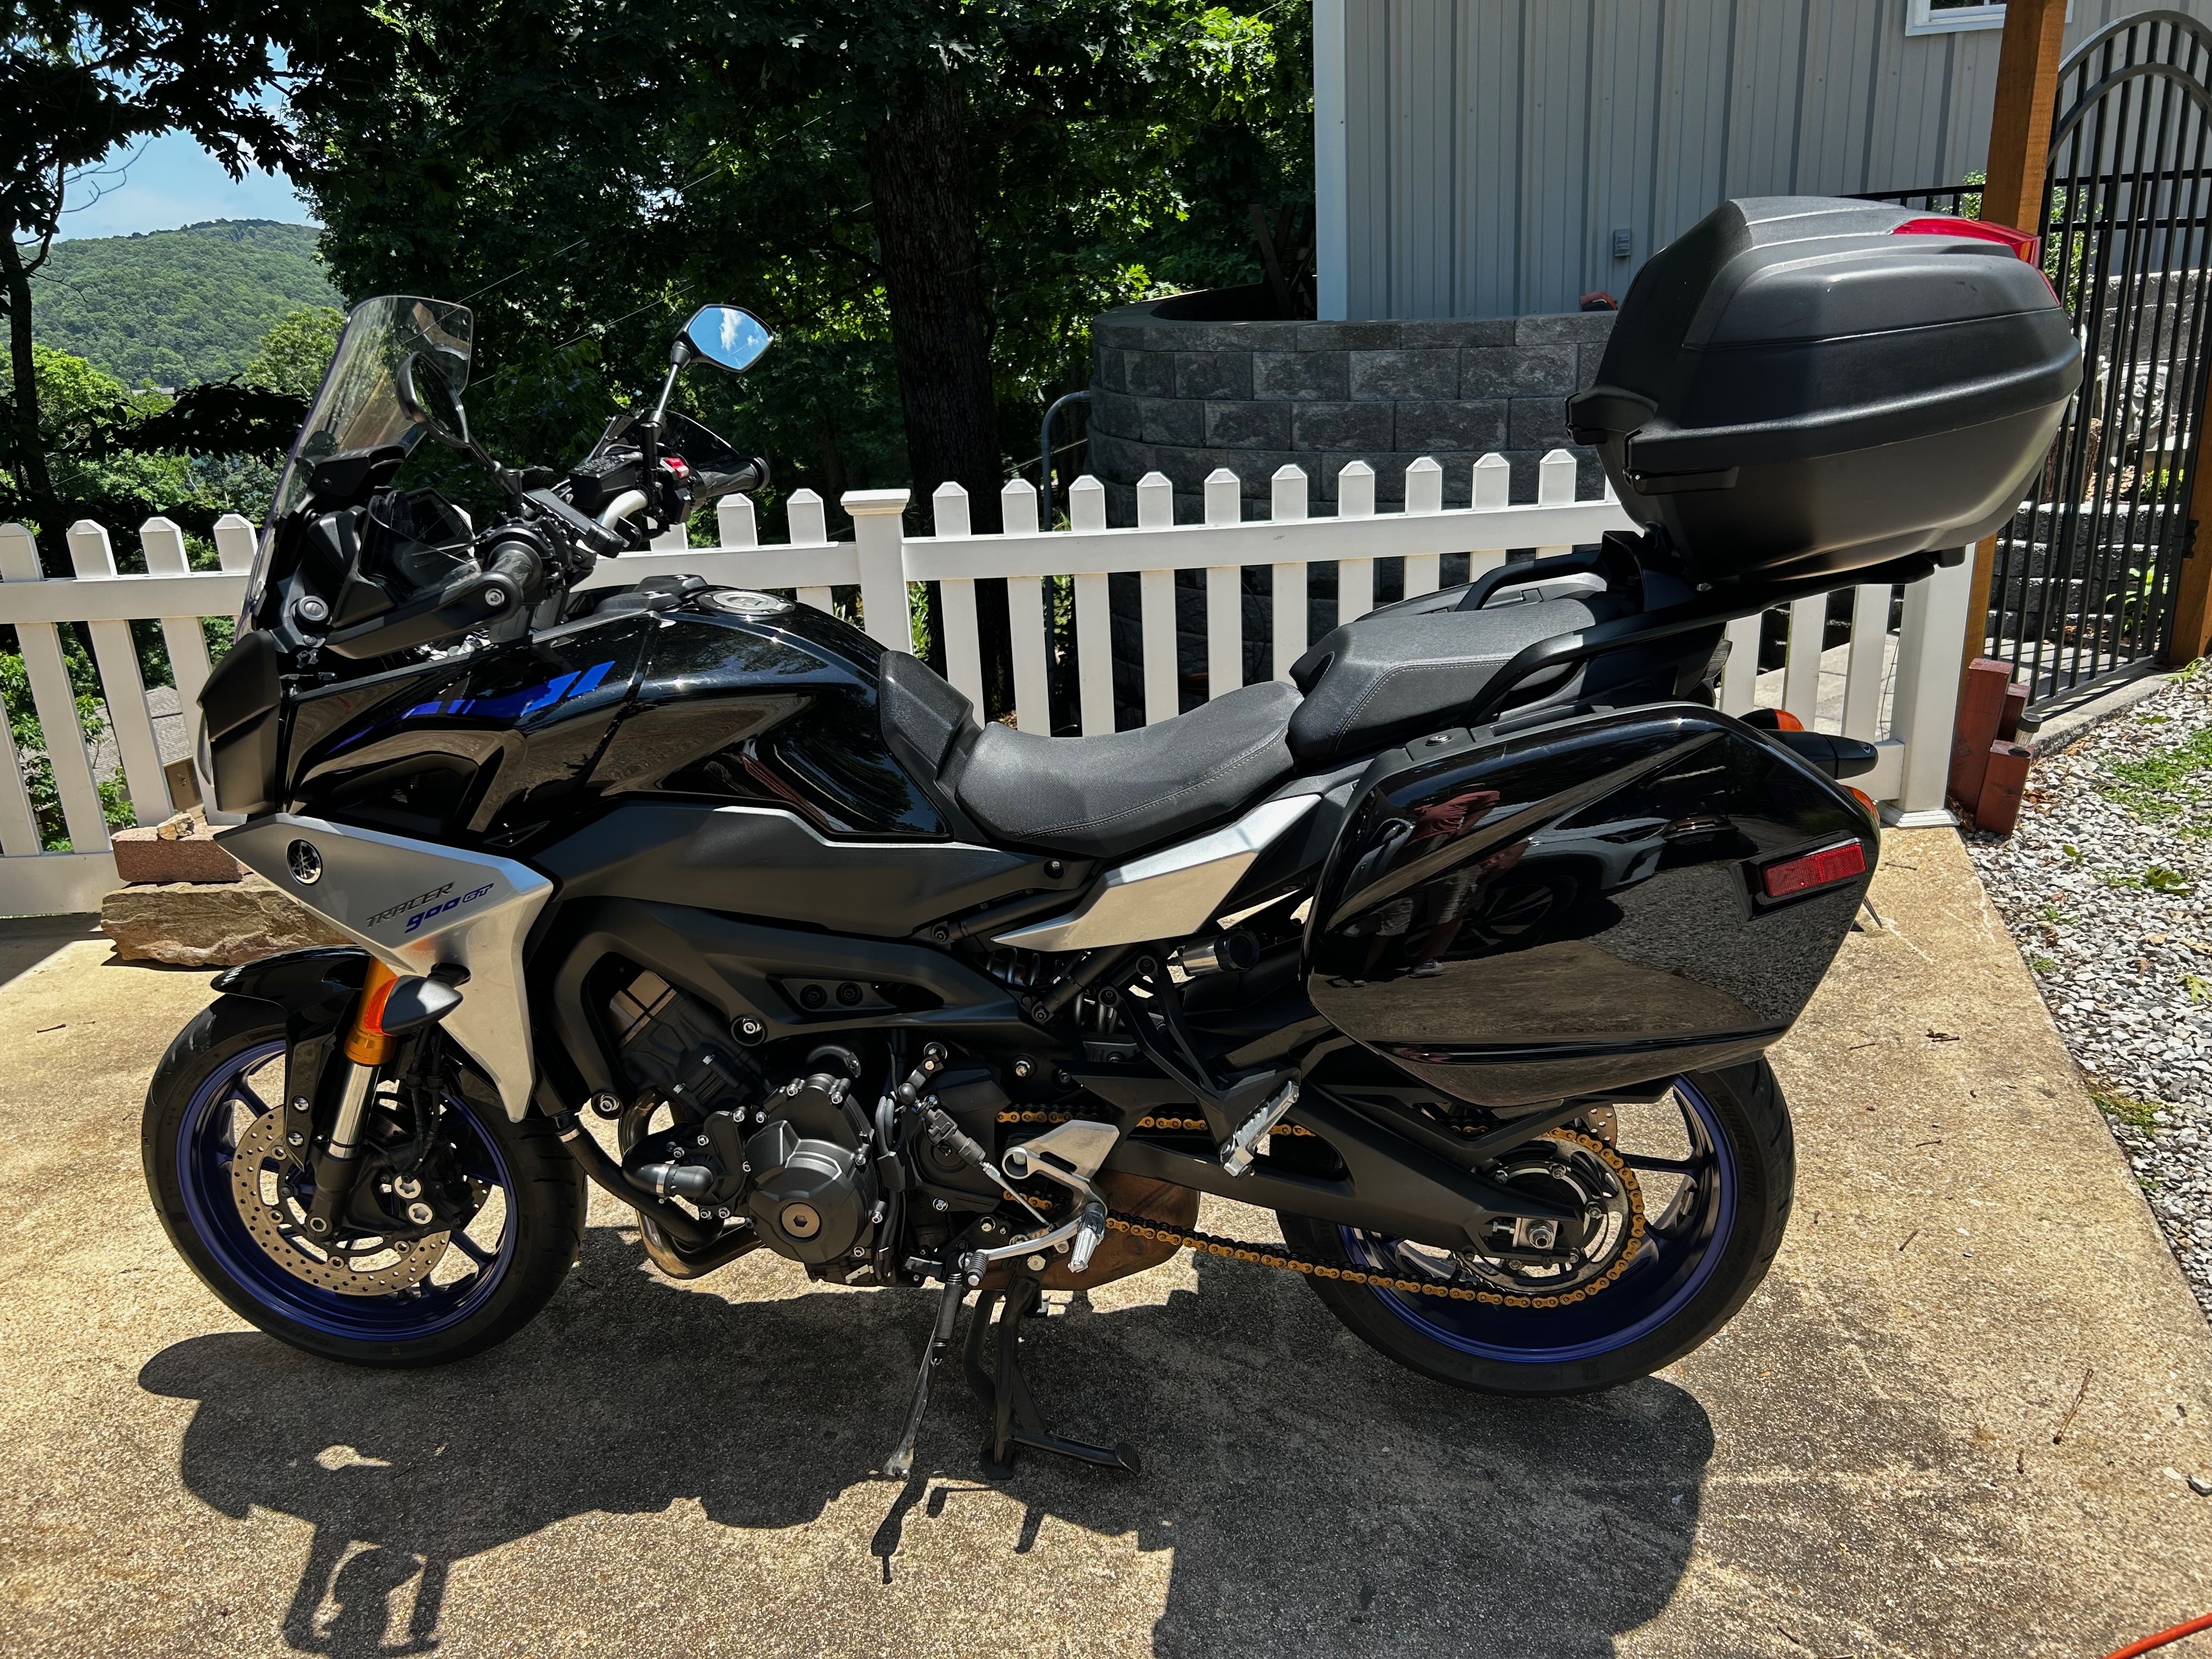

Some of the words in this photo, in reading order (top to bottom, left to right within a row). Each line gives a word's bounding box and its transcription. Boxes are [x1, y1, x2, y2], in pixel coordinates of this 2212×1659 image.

[366, 881, 456, 929] TRACER
[404, 896, 461, 934] 900
[462, 883, 494, 904] GT
[1716, 1096, 1758, 1203] BRIDGESTONE
